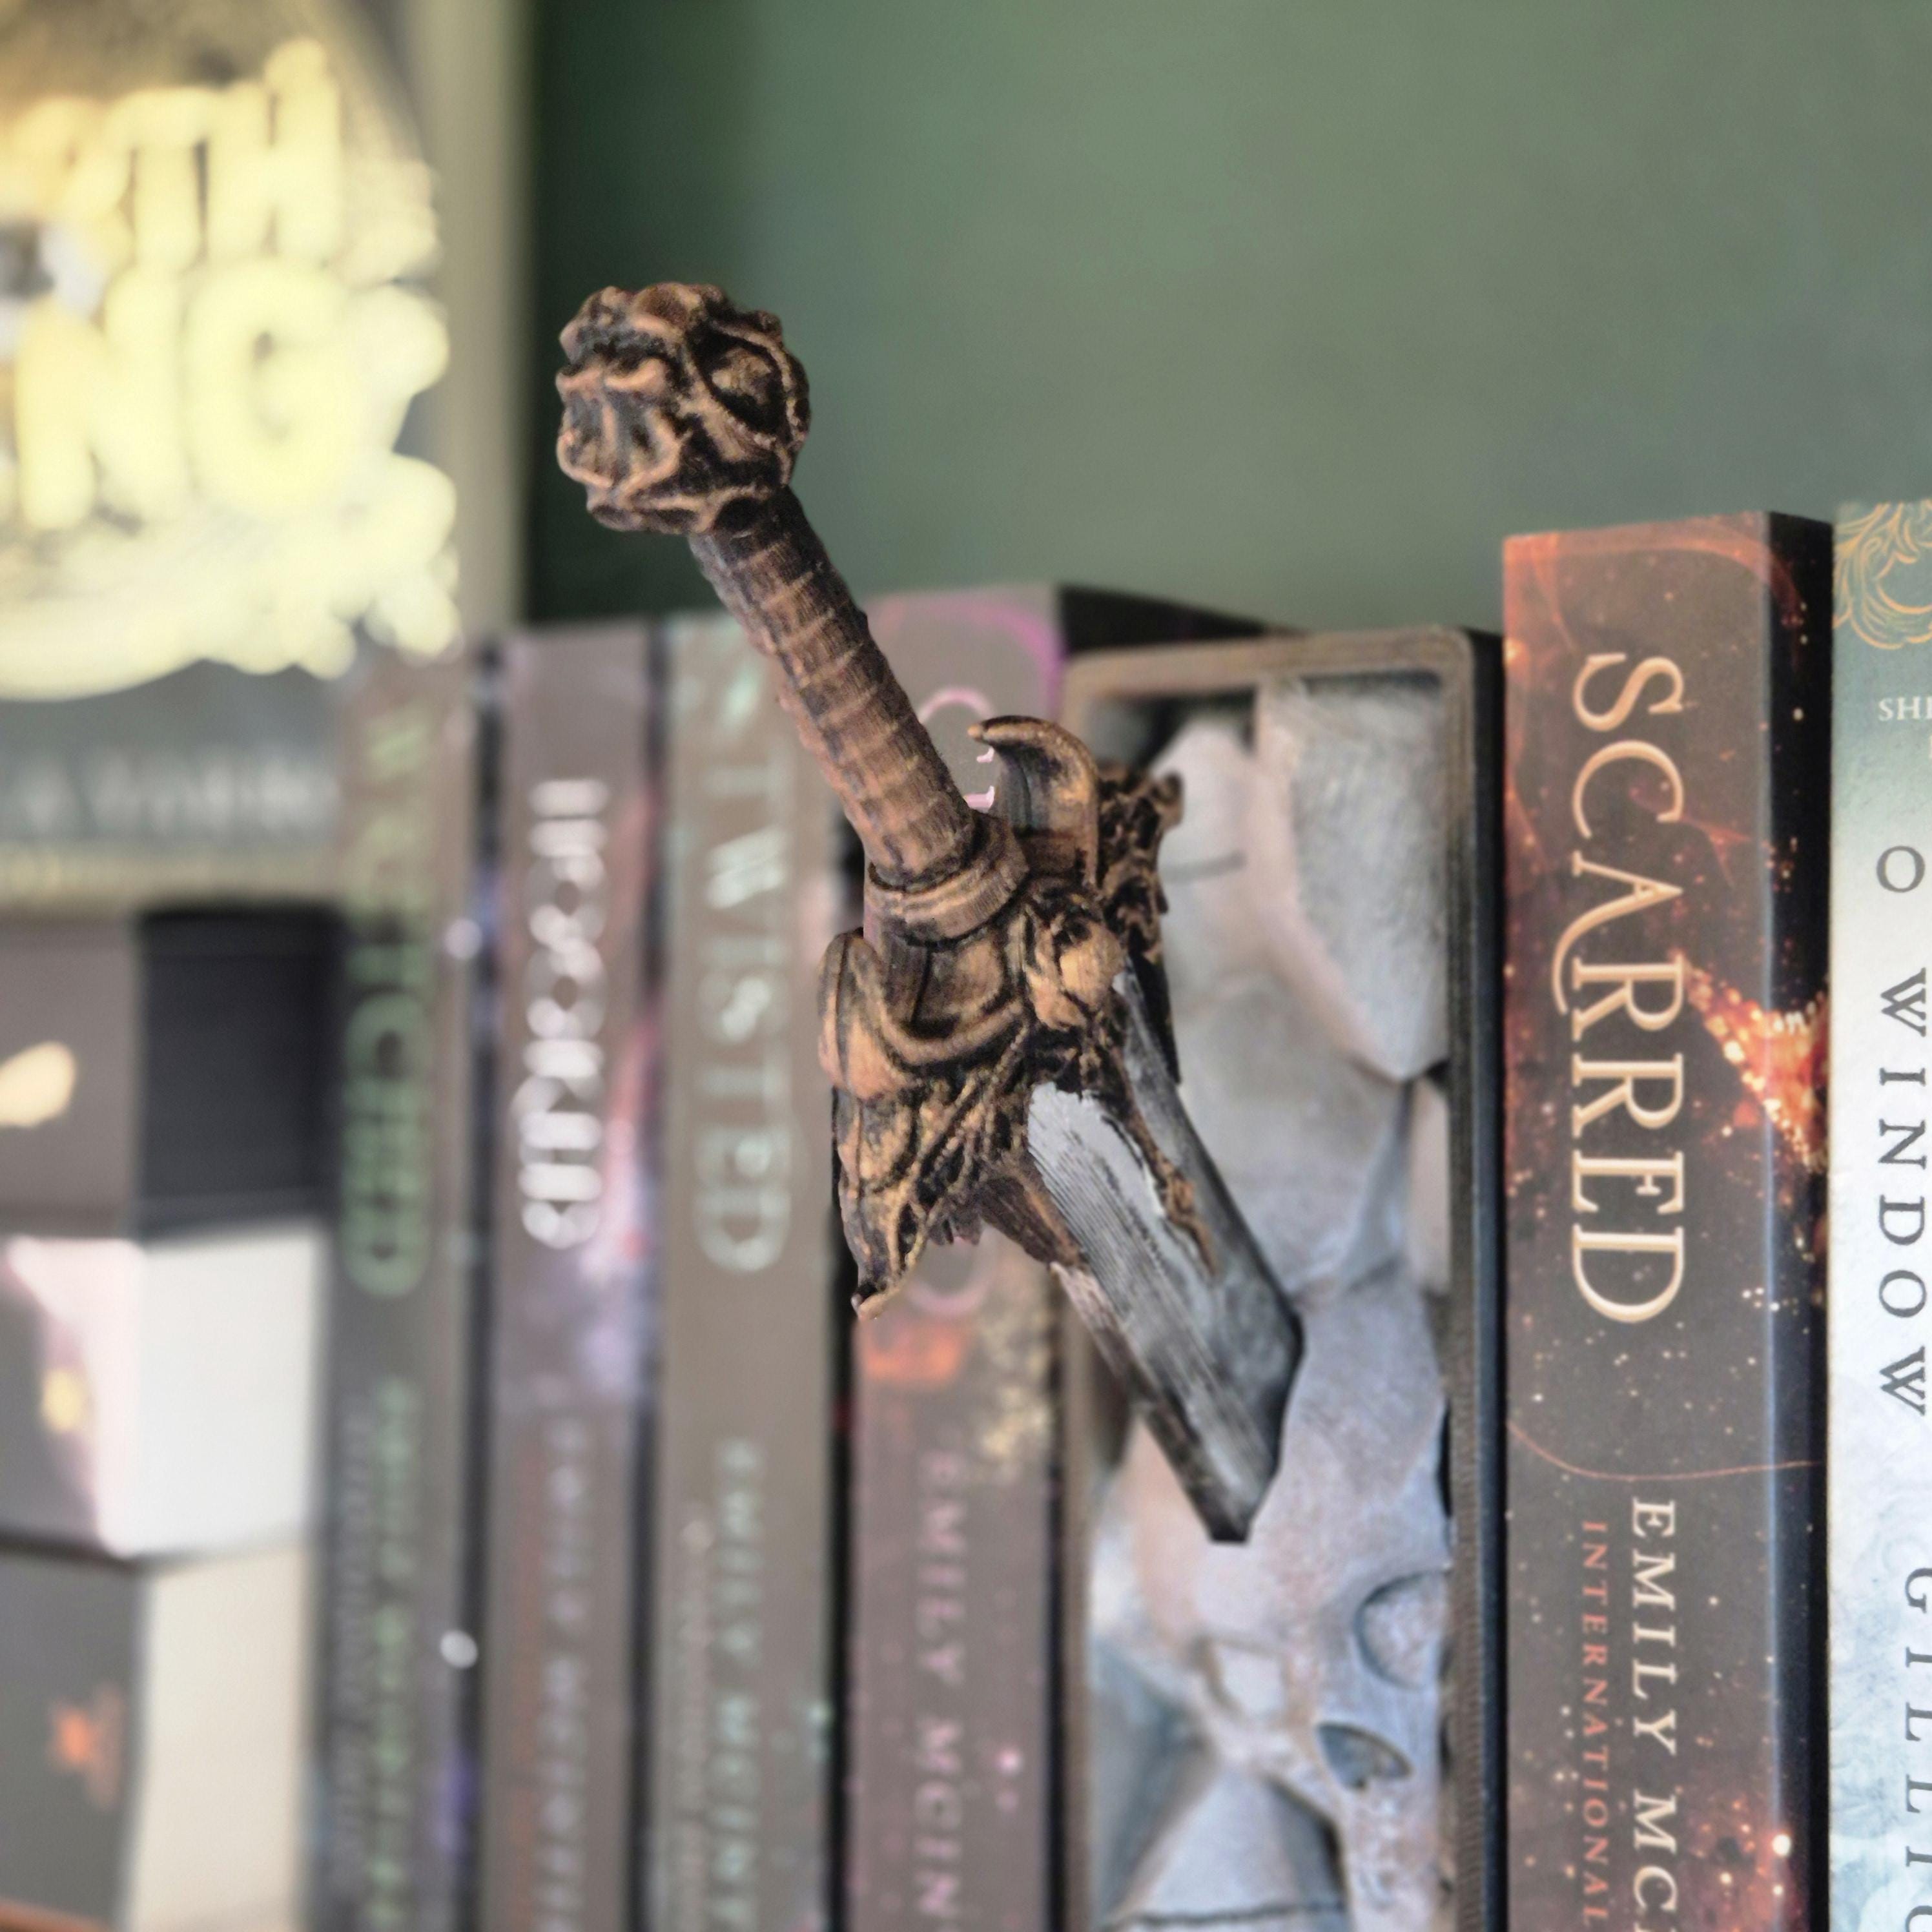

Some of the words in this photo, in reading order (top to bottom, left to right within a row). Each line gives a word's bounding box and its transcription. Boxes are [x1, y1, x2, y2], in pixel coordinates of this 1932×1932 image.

[1552, 652, 1685, 1323] SCARRED
[1877, 967, 1927, 1416] WINDOW
[914, 1450, 967, 1684] EMILY
[1581, 1519, 1609, 1928] INTERNATIONAL
[1630, 1497, 1677, 1755] EMILY
